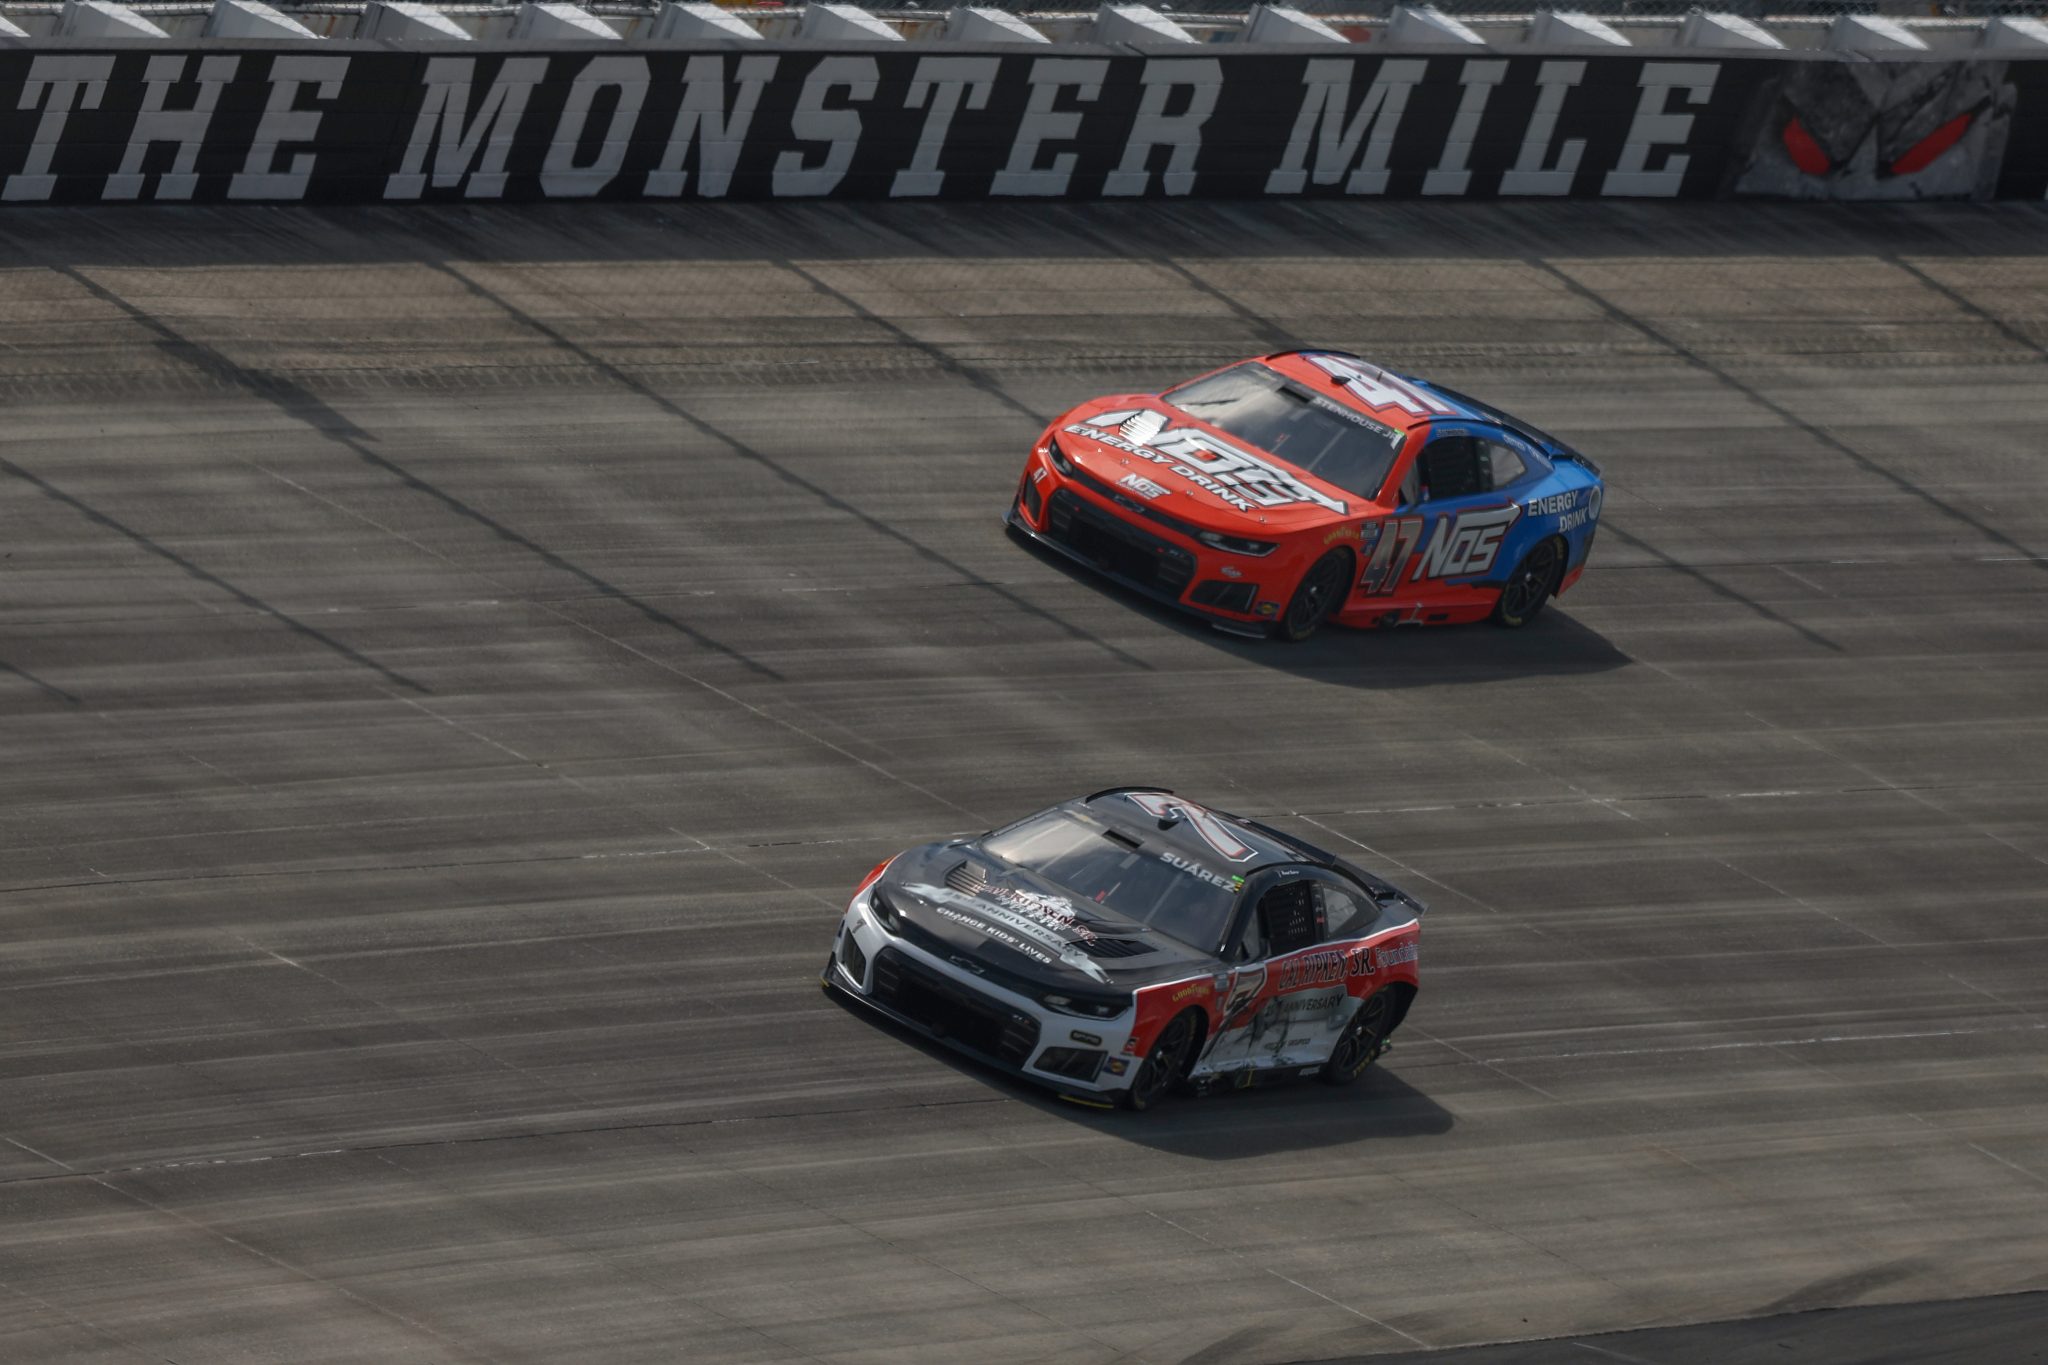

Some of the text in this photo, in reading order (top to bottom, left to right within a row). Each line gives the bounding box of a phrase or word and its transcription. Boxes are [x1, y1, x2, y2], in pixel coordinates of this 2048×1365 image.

[2, 54, 1721, 200] THE MONSTER MILE
[1311, 396, 1384, 434] STENHOUSE
[1062, 424, 1175, 464] ENERGY
[1168, 465, 1259, 511] DRINK
[1118, 472, 1172, 499] NOS
[1528, 490, 1579, 516] ENERGY
[1559, 507, 1588, 533] DRINK
[1359, 516, 1424, 596] 47
[1411, 502, 1523, 582] NOS
[1160, 852, 1236, 893] SUÁREZ
[936, 906, 986, 930] CHANGE
[1019, 942, 1053, 964] LIVES
